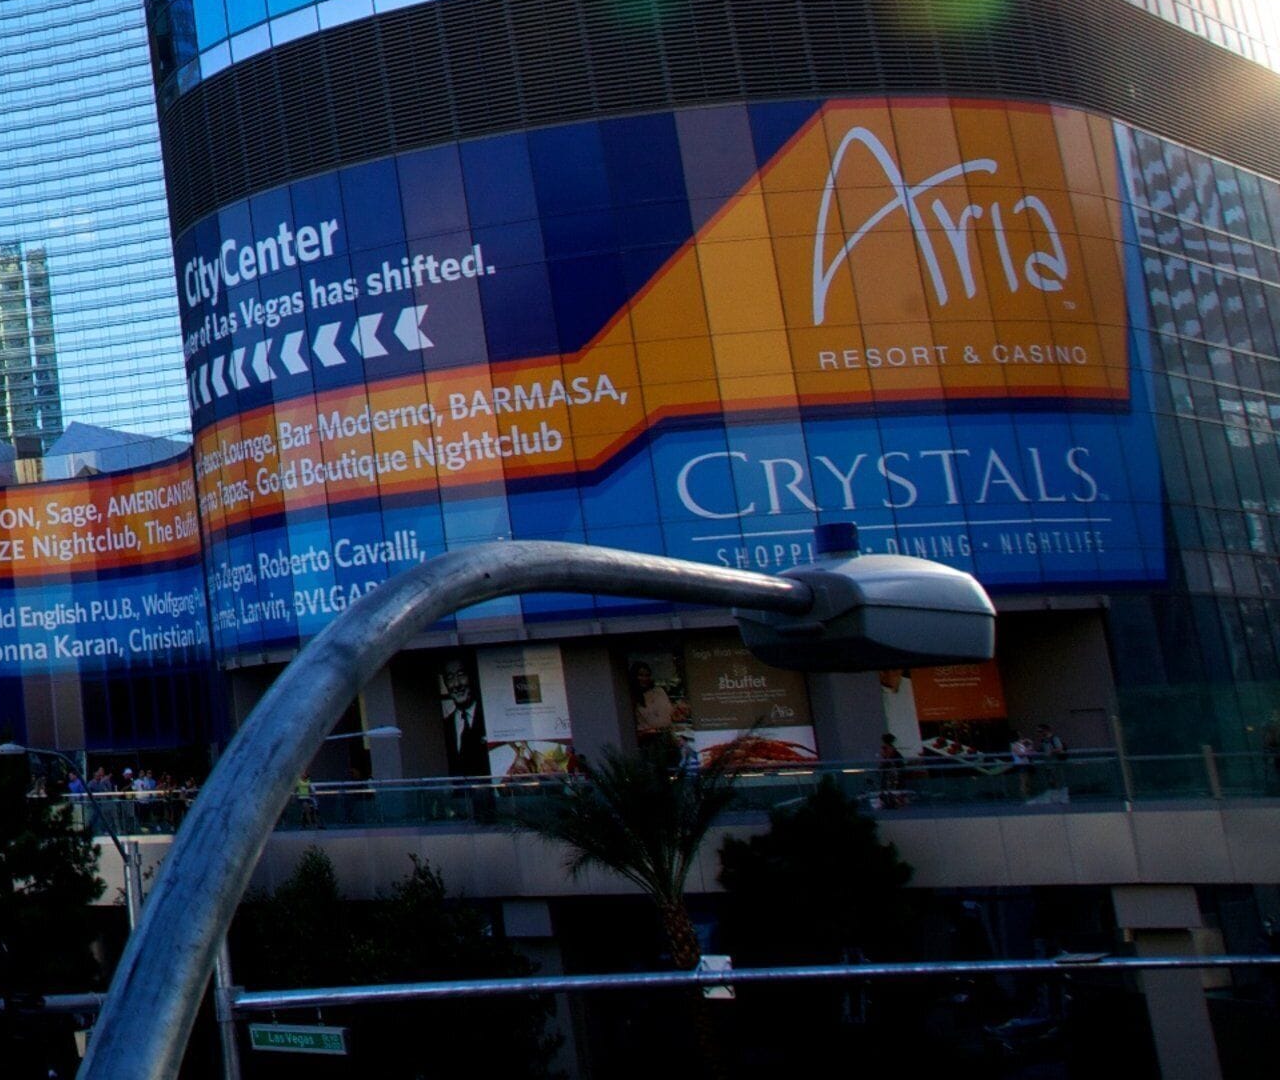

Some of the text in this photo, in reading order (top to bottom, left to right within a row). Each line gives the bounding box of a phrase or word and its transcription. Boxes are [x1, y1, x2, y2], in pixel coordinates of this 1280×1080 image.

[812, 126, 1068, 325] Aria
[184, 218, 339, 308] CityCenter
[212, 311, 238, 340] Las
[239, 290, 304, 328] Vegas
[309, 275, 359, 310] has
[367, 244, 496, 296] shifted.
[818, 344, 1088, 370] RESORT & CASINO
[221, 374, 628, 463] Lounge, Bar Moderno, BARMASA,
[256, 460, 298, 496] Gold
[299, 448, 407, 491] Boutique
[411, 421, 563, 470] Nightclub
[45, 502, 103, 527] Sage,
[107, 483, 181, 518] AMERICAN
[676, 446, 1099, 520] CRYSTALS
[32, 524, 142, 561] Nightclub,
[143, 518, 174, 545] The
[258, 545, 331, 580] Roberto
[334, 530, 426, 568] Cavalli,
[716, 530, 1106, 570] SHOPPI DINING NIGHTLIFE
[19, 601, 88, 630] English
[90, 598, 141, 622] P.U.B.,
[142, 591, 196, 618] Wolfgang
[240, 592, 290, 625] Lanvin,
[293, 578, 387, 617] BVLGA
[53, 633, 124, 659] Karan,
[129, 624, 196, 653] Christian
